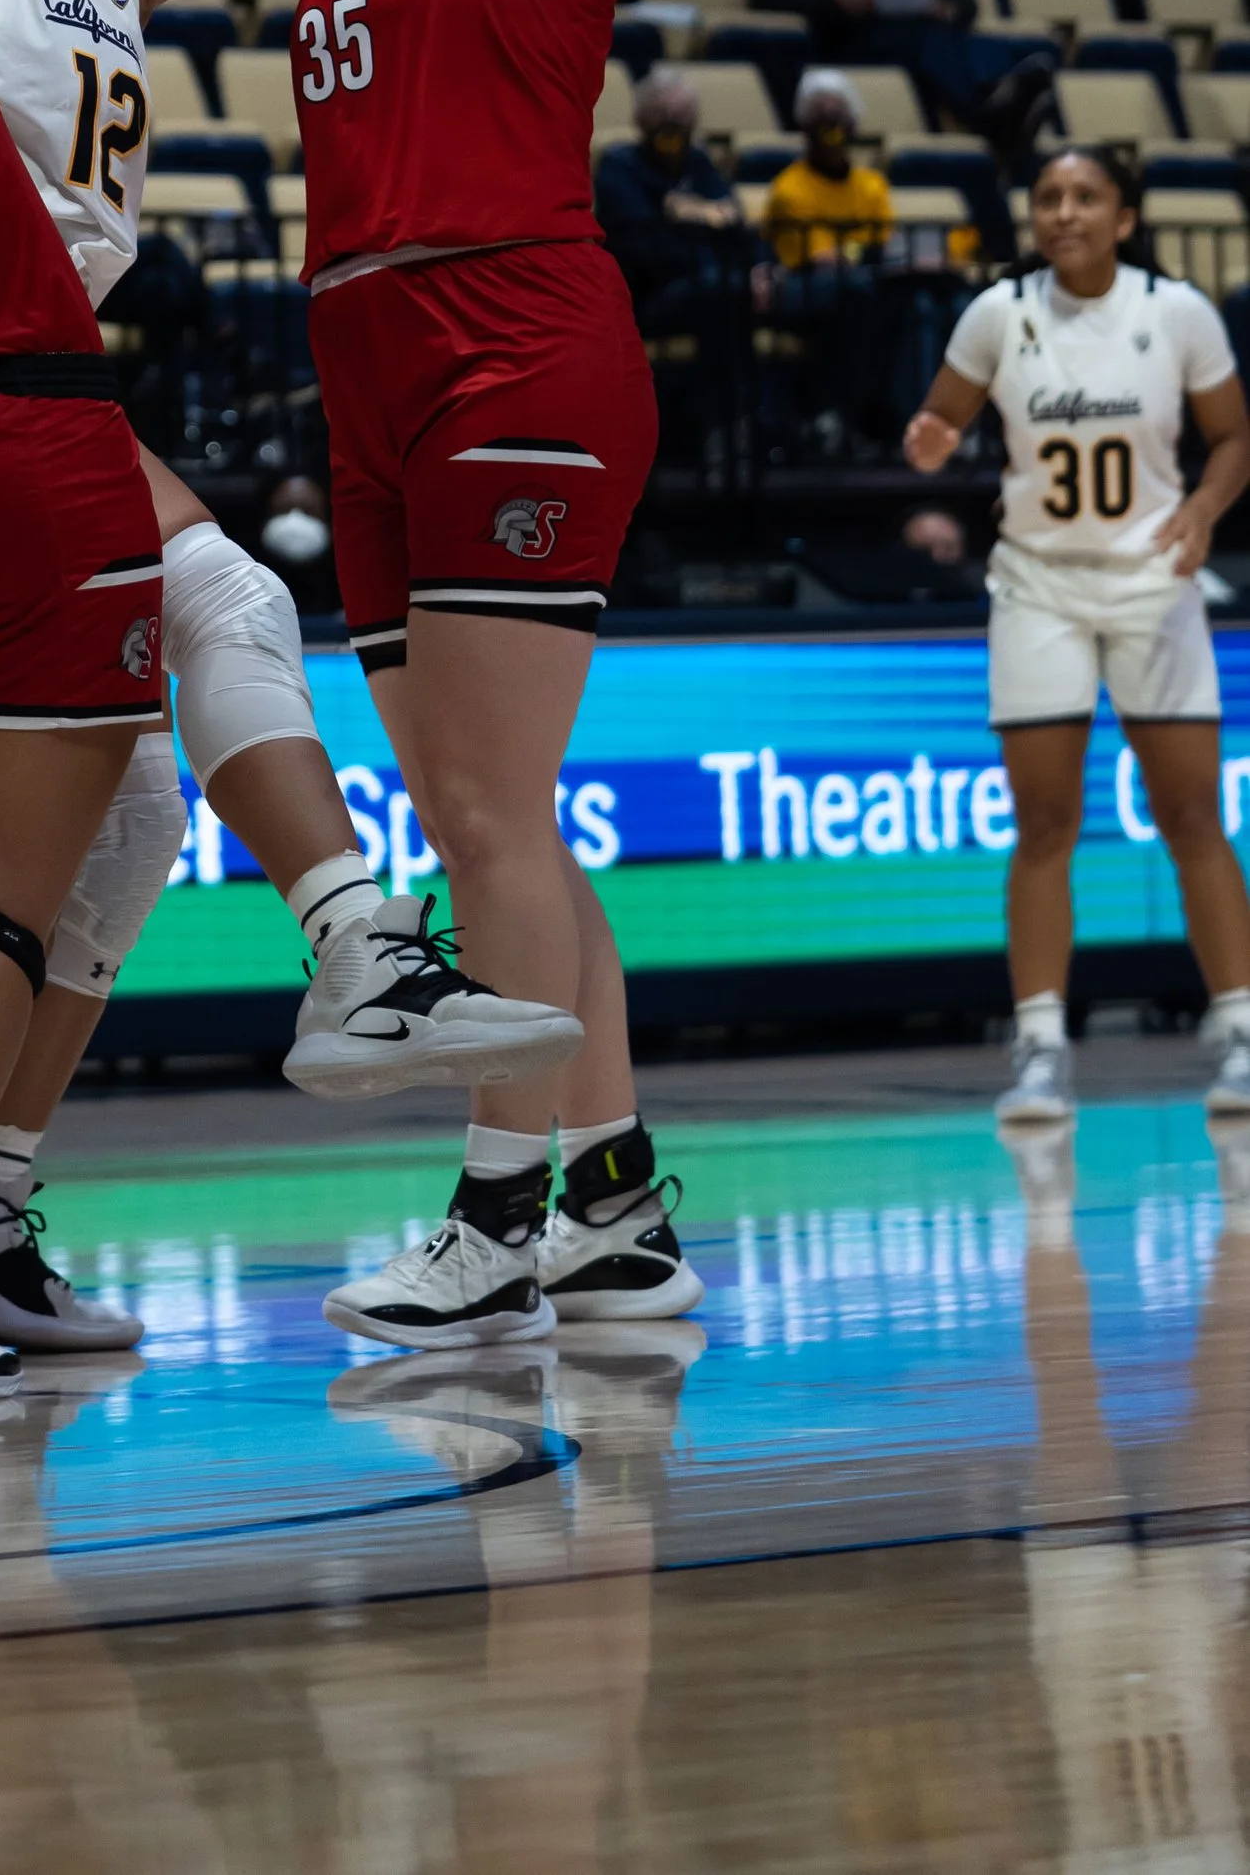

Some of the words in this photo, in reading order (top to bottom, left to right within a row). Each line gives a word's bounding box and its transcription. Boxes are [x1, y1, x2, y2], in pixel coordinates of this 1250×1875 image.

[65, 47, 148, 214] 12
[1028, 389, 1142, 425] California
[1037, 436, 1136, 520] 30
[698, 745, 1018, 864] Theatre
